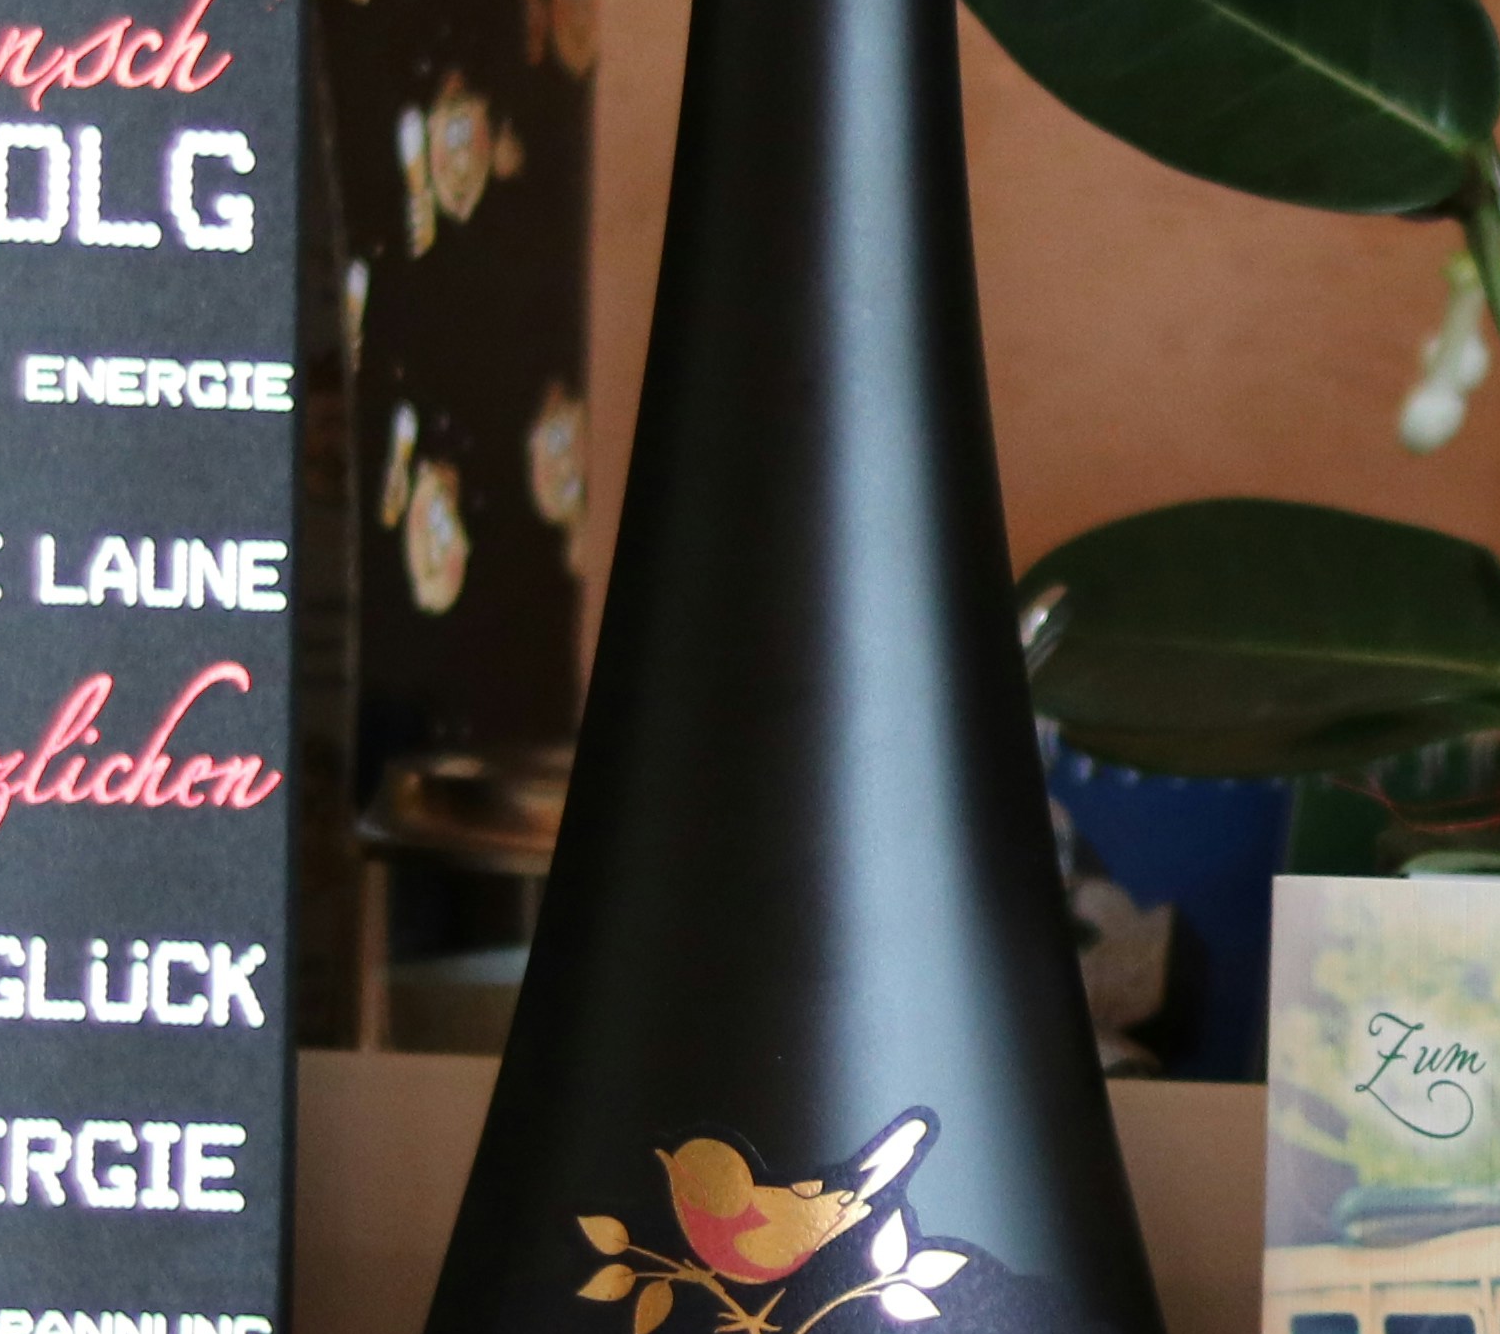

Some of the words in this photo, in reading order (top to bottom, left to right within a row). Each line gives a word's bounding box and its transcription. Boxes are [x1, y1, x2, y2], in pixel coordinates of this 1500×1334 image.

[21, 355, 295, 412] ENERGIE
[36, 534, 288, 611] LAUNE
[1353, 1009, 1487, 1140] Zum
